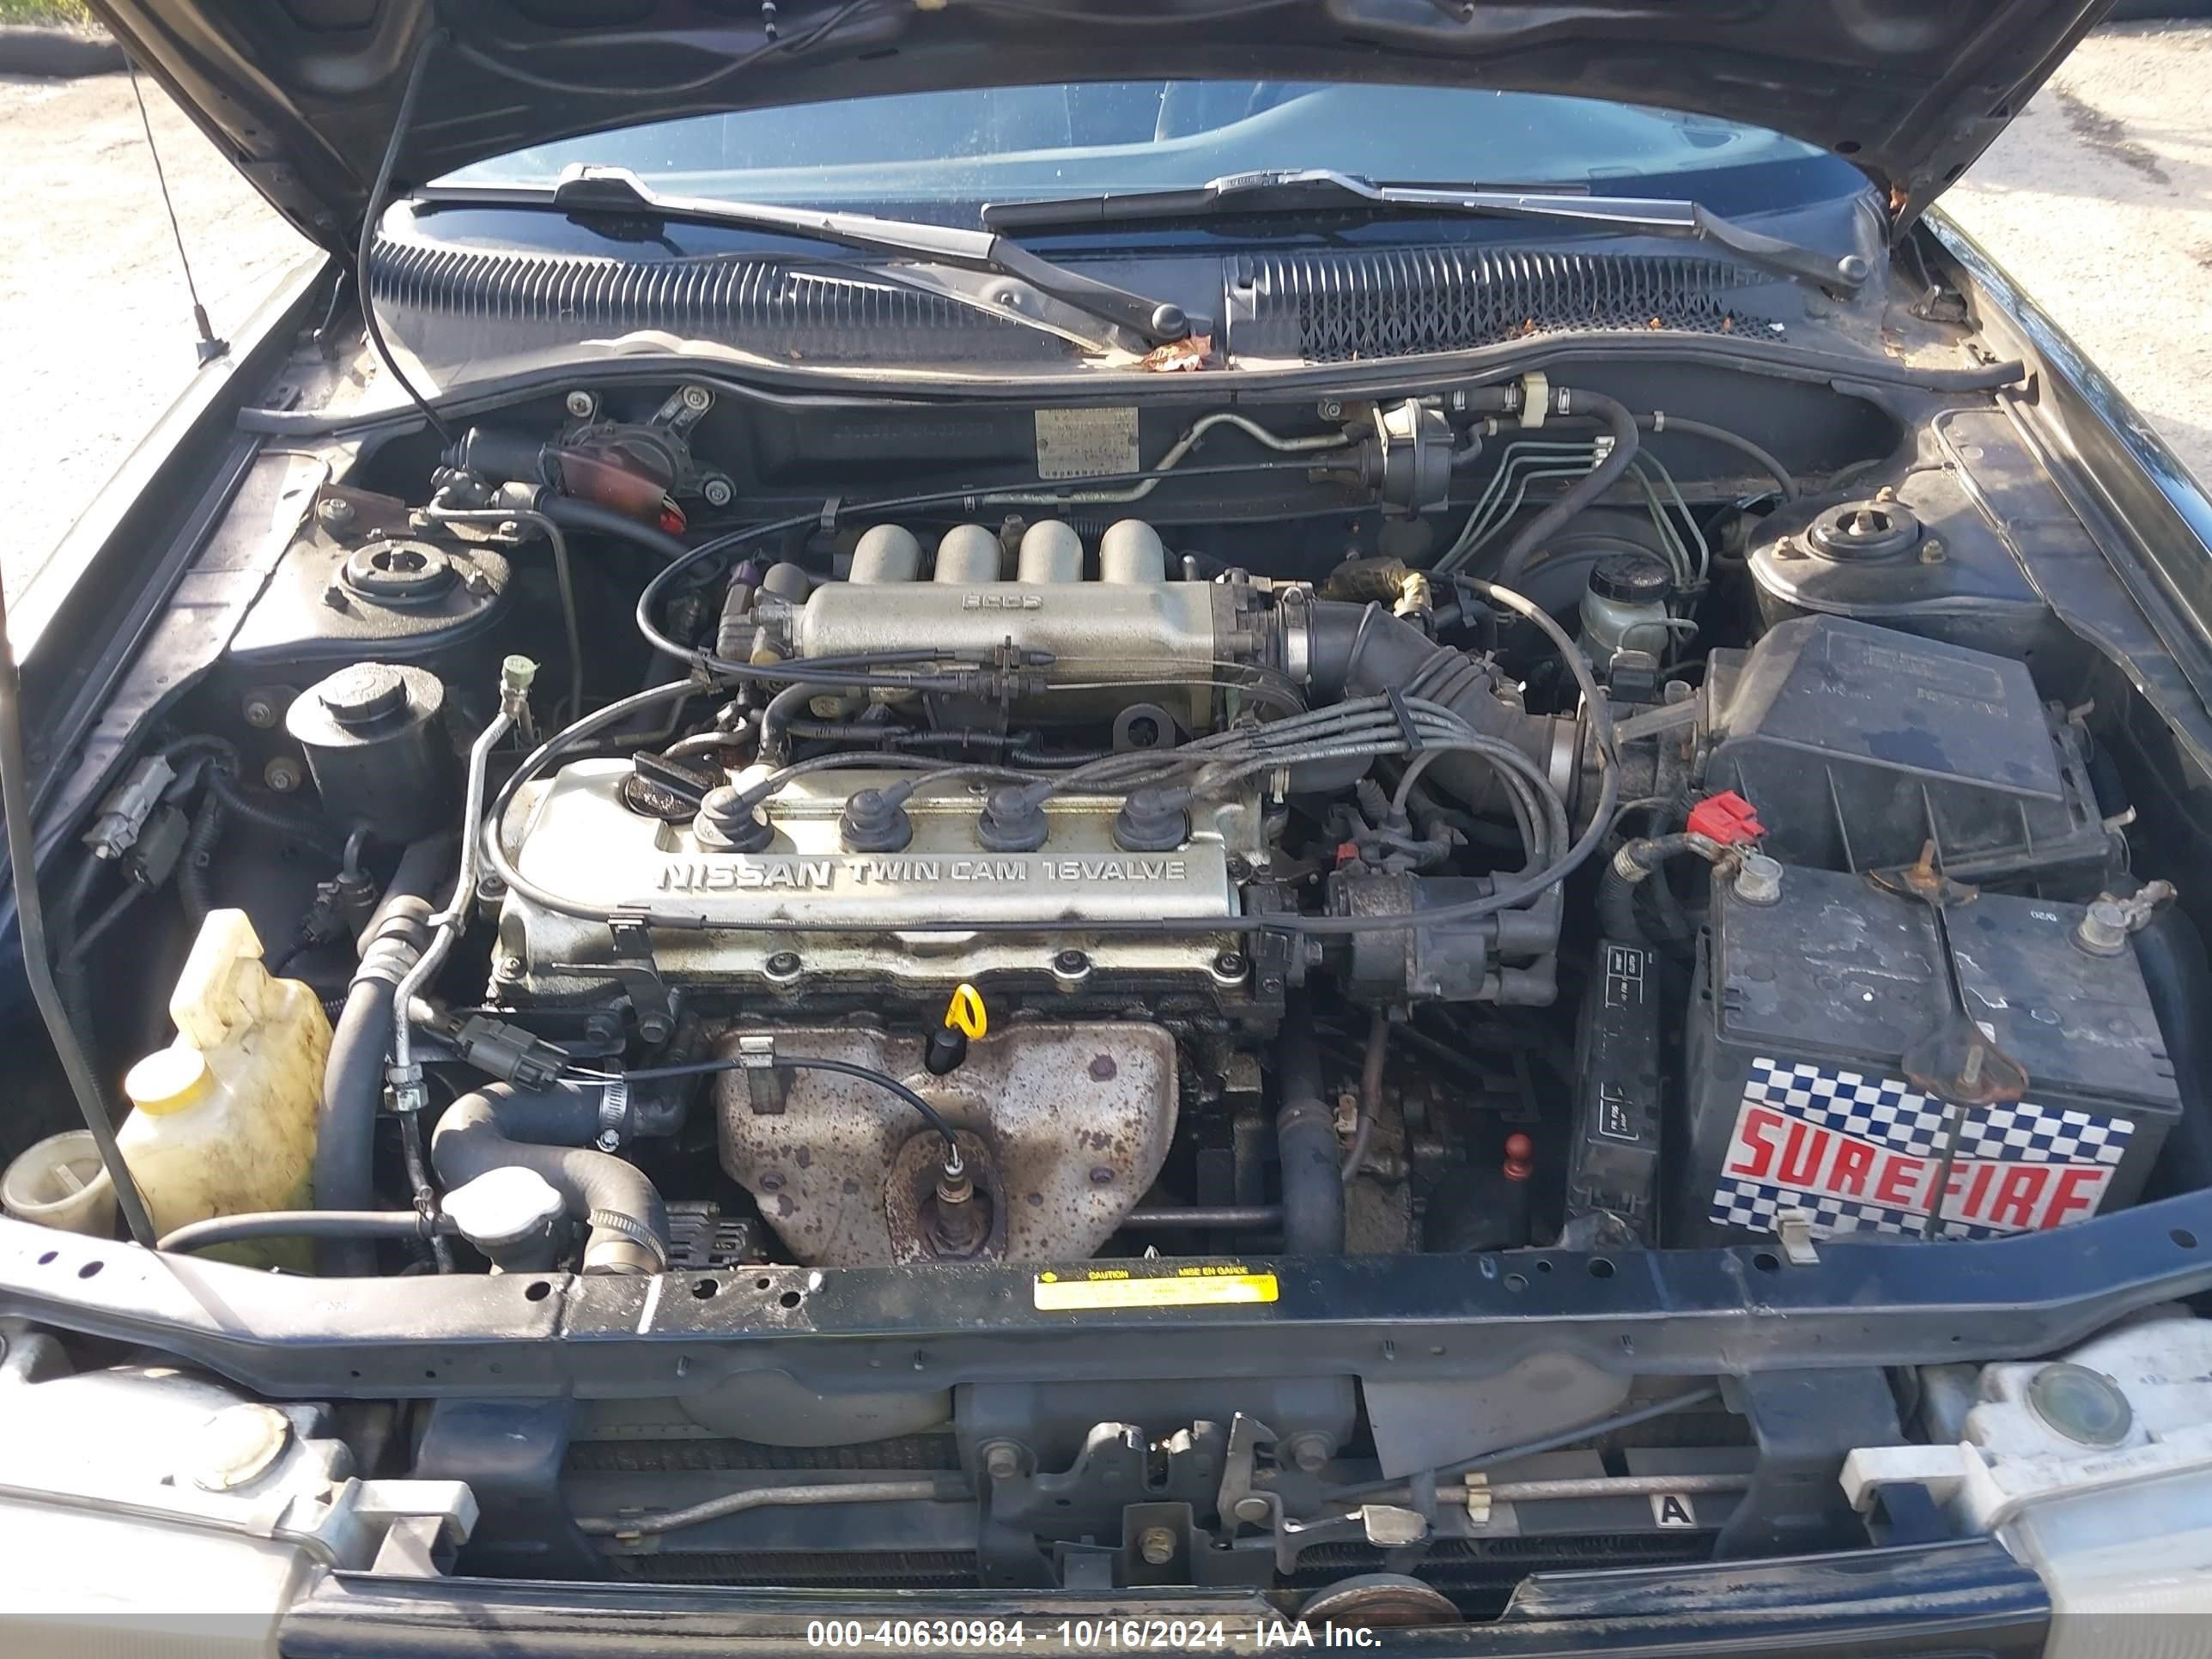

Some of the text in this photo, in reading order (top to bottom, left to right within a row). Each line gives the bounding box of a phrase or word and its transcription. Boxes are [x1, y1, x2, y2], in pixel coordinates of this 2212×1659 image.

[656, 860, 1185, 890] NISSAN TWIN CAM 16VALVE
[1089, 1270, 1128, 1279] CAUTION
[1178, 1265, 1249, 1276] MISE EN GARDE
[1662, 1496, 1692, 1522] A
